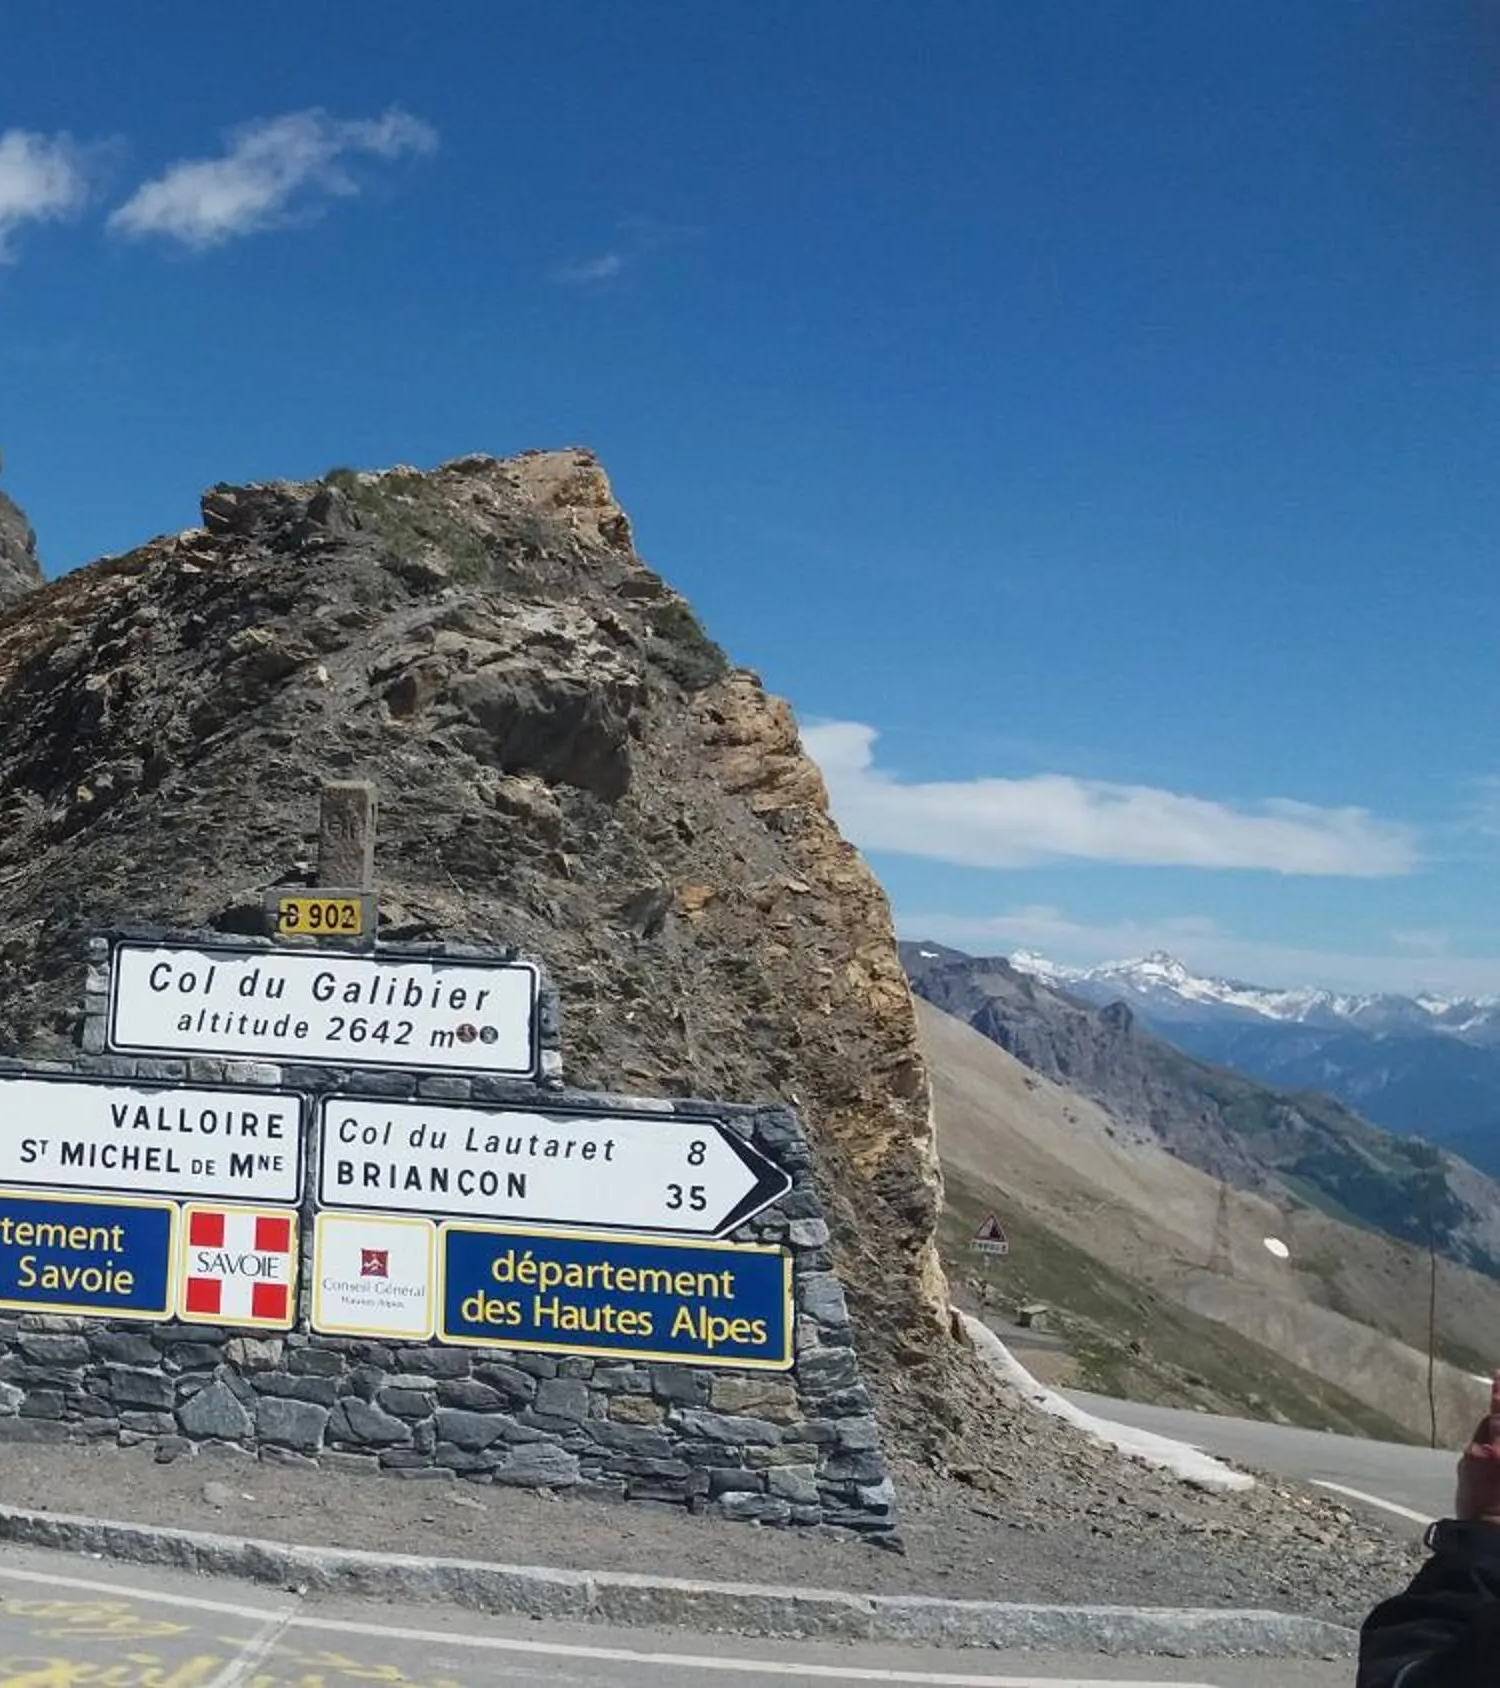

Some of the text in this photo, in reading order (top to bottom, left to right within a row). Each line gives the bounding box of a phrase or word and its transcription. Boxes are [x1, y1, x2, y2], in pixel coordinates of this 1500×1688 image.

[308, 903, 355, 929] 902
[149, 962, 491, 1011] Col du Galibier
[177, 1010, 455, 1048] altitude 2642 m
[111, 1103, 284, 1138] VALLOIRE
[61, 1142, 180, 1174] MICHEL
[191, 1158, 216, 1176] DE
[230, 1153, 284, 1179] MNE
[339, 1118, 707, 1167] Col du Lautaret 8
[337, 1161, 708, 1211] BRIANÇON 35
[18, 1256, 134, 1295] Savoie
[197, 1252, 280, 1279] SAVOIE
[491, 1249, 736, 1300] département
[323, 1279, 425, 1298] Conseil Général
[461, 1290, 768, 1349] des Hautes Alpes
